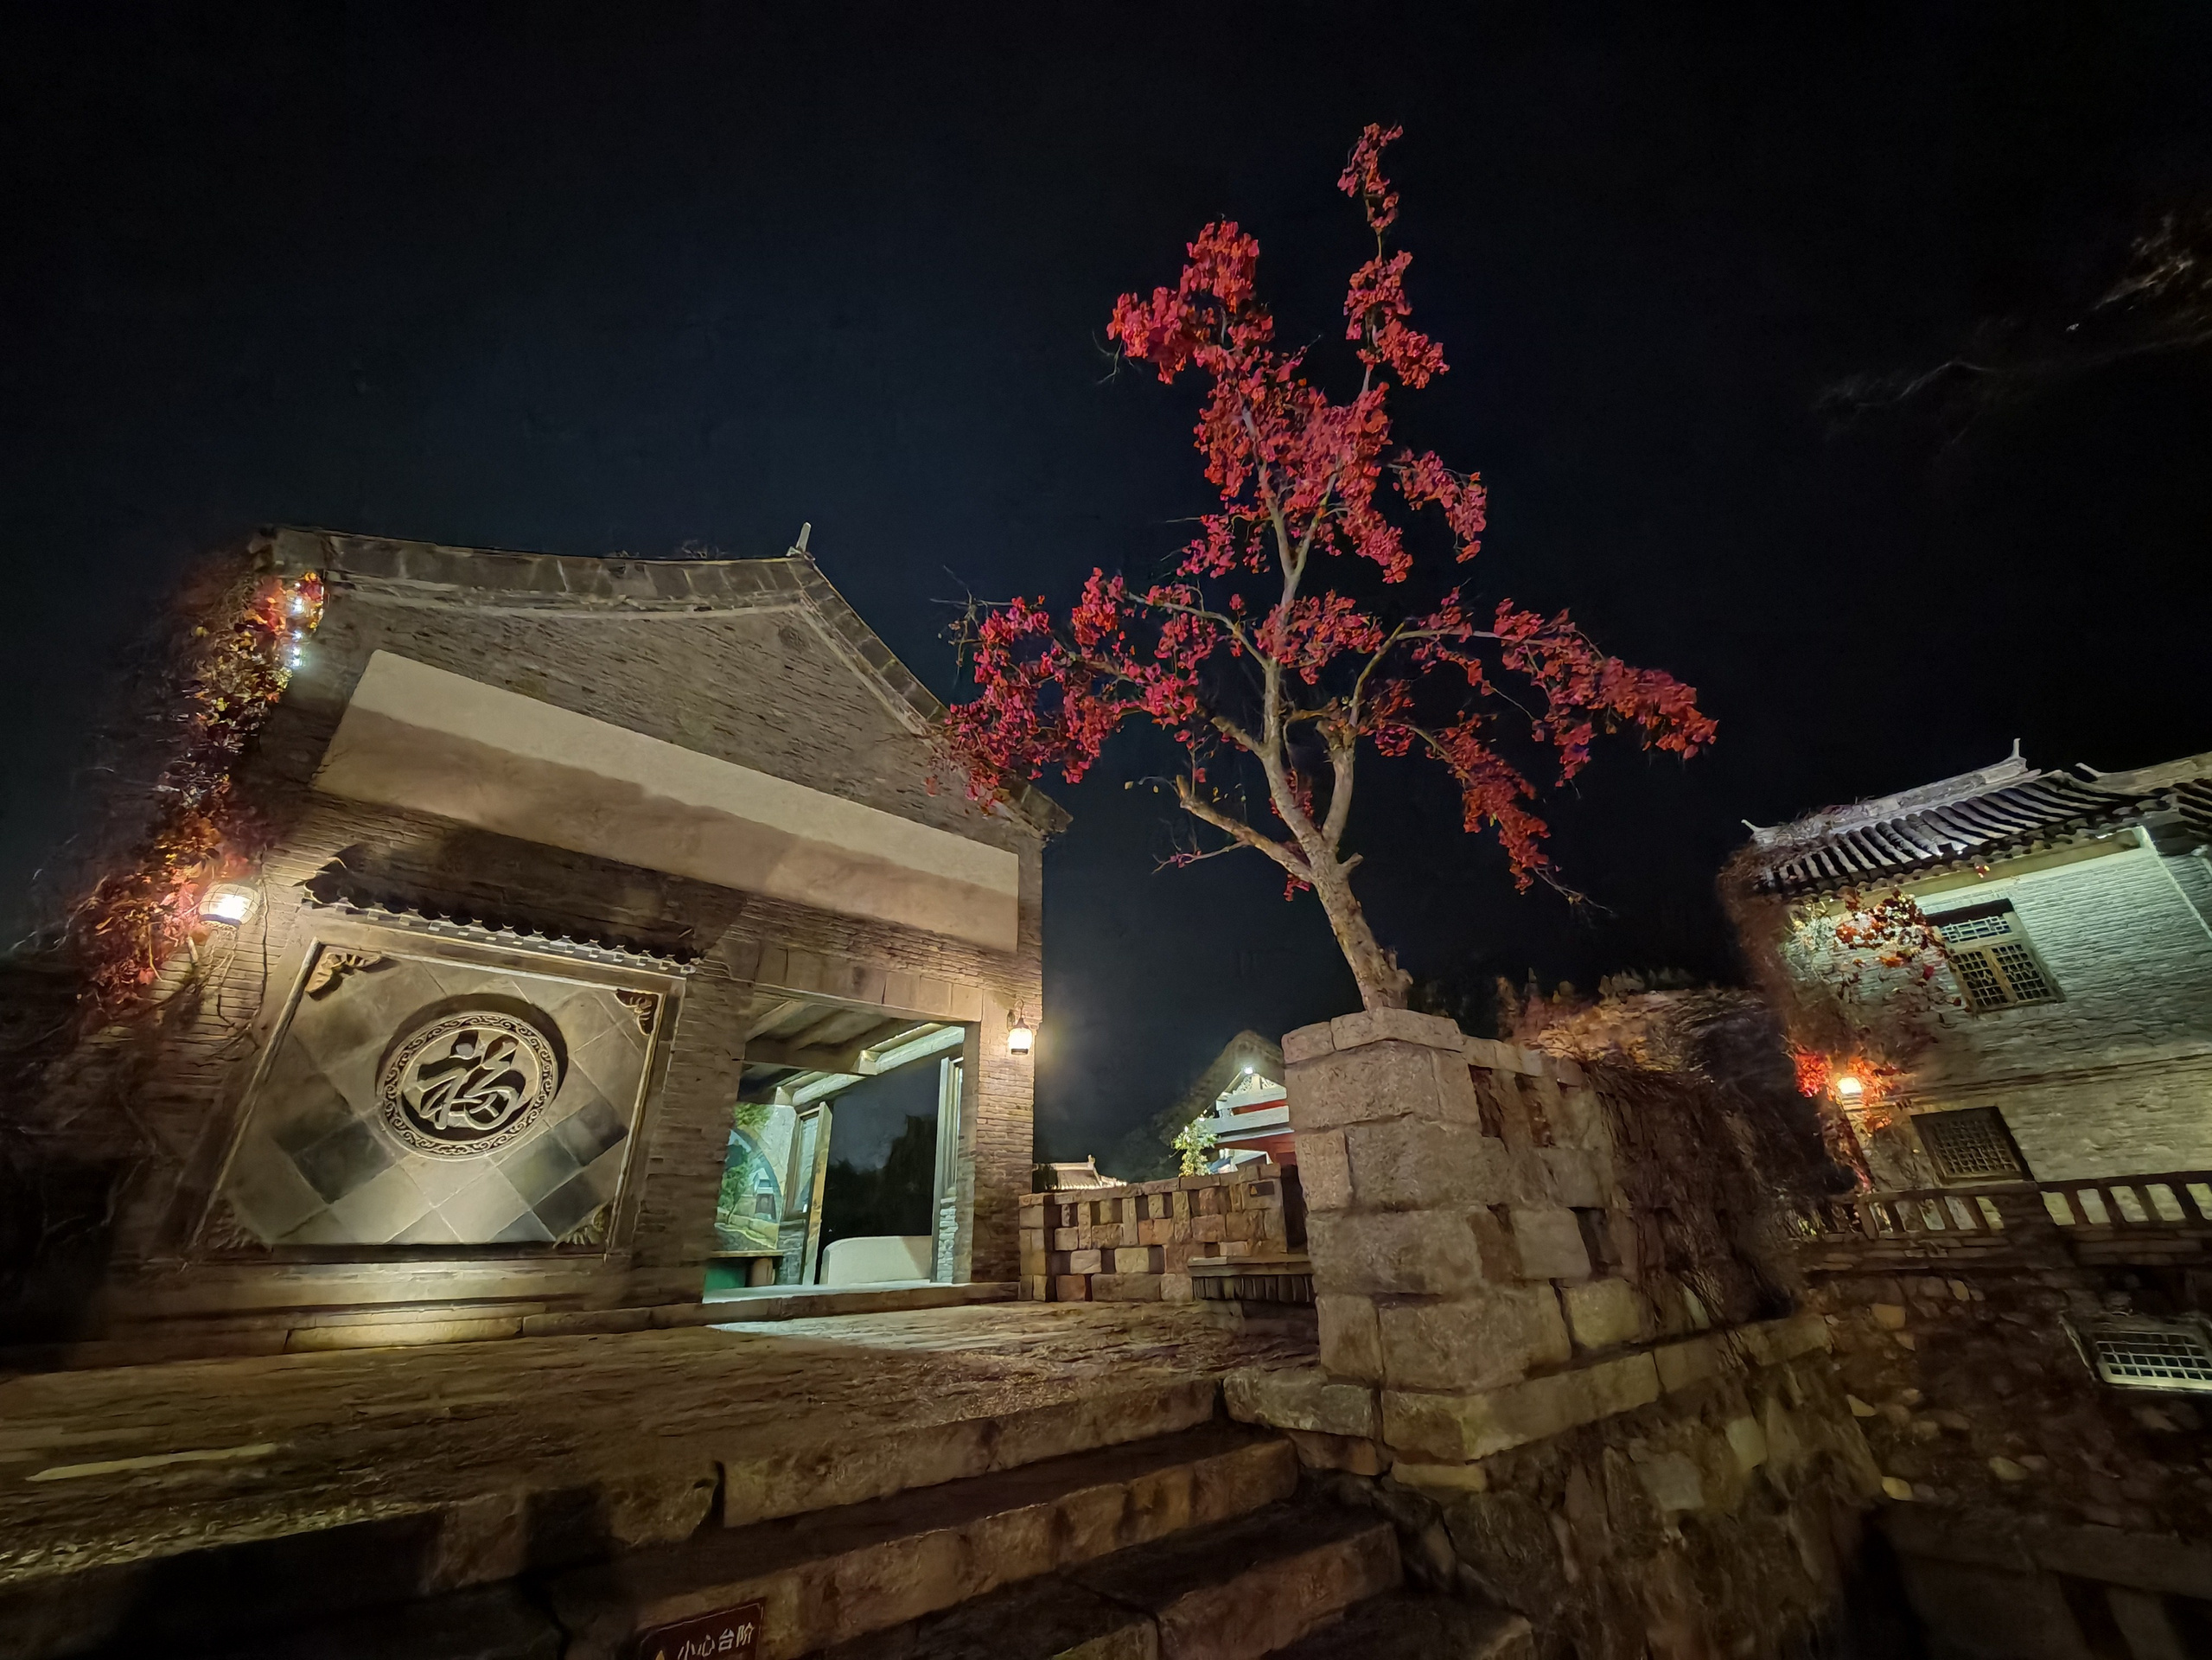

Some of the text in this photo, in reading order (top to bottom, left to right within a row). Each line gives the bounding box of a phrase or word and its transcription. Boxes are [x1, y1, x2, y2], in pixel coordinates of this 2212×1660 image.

[417, 1041, 520, 1131] 福
[677, 1622, 755, 1660] 小心台阶
